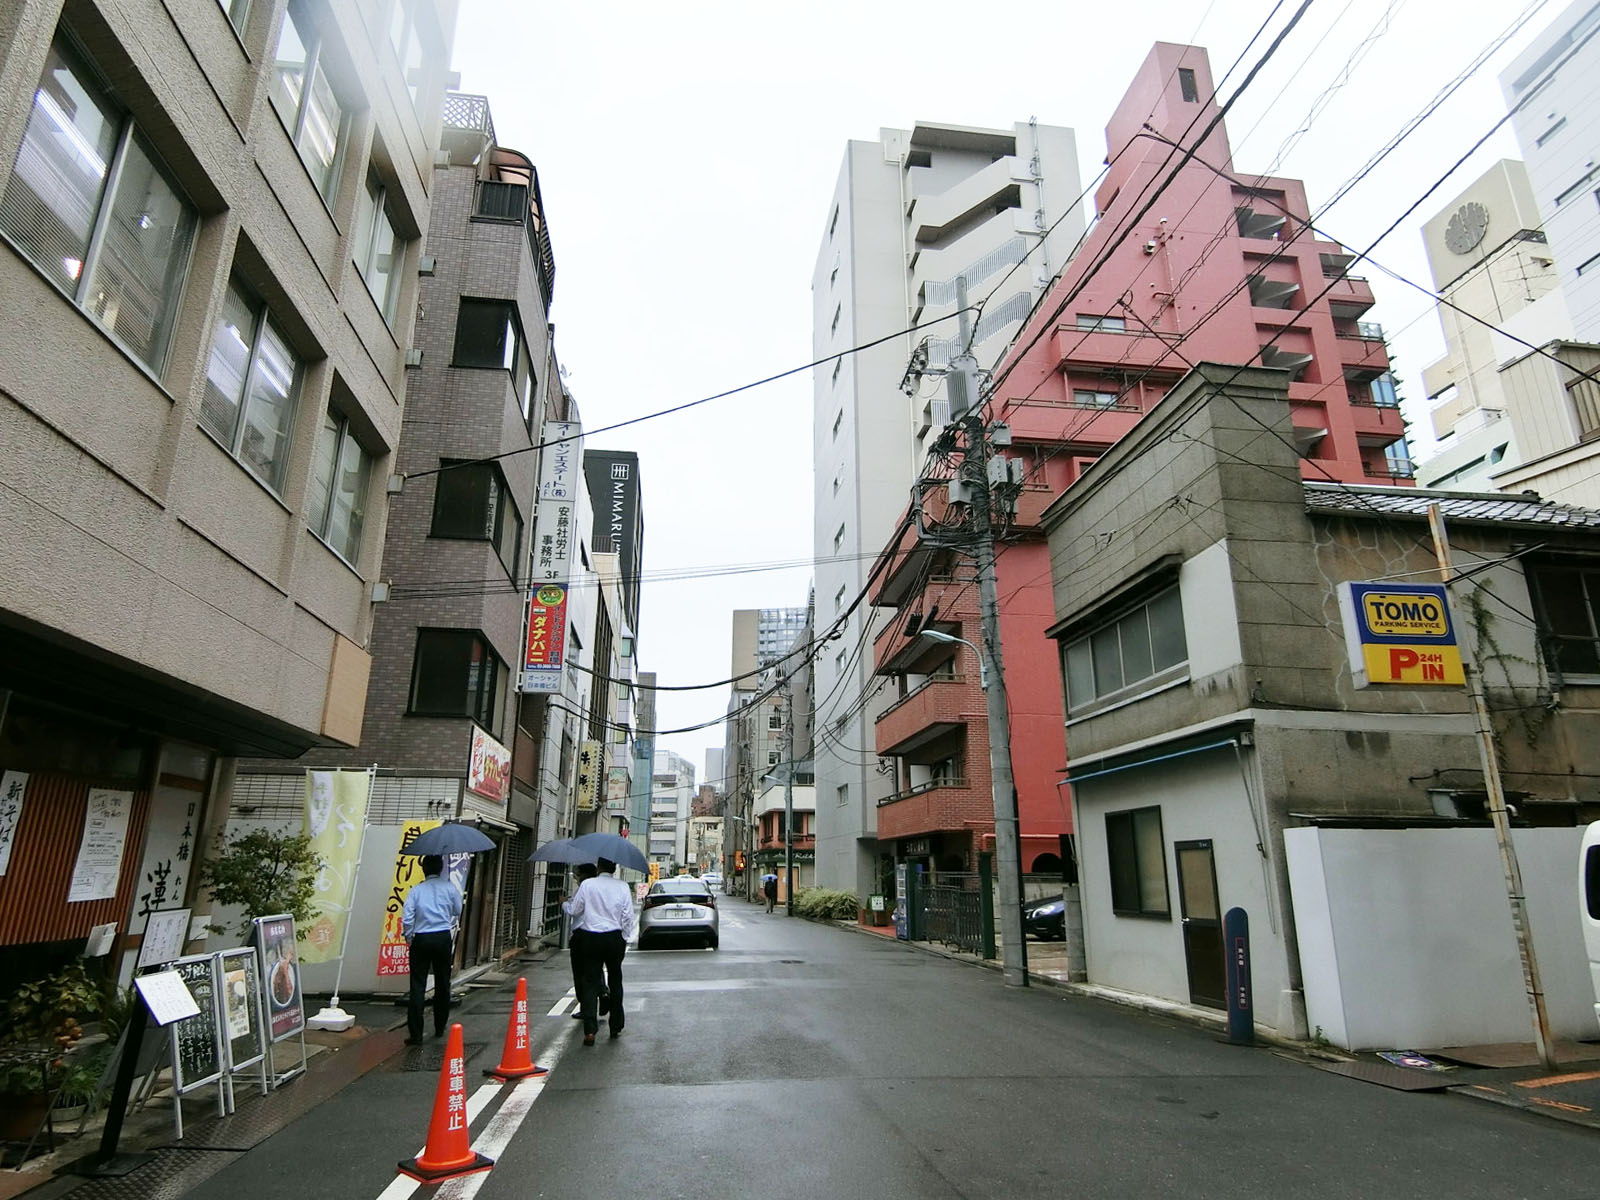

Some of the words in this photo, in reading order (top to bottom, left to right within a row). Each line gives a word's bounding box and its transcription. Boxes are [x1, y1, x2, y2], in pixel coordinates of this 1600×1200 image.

[555, 506, 570, 560] 安藤社労士
[540, 534, 554, 568] 事務所
[545, 571, 559, 580] 3F
[1370, 602, 1439, 621] TOMO
[1389, 648, 1419, 680] P
[1420, 654, 1442, 662] 24H
[1422, 664, 1444, 680] IN
[176, 802, 196, 862] 日本橋
[515, 1000, 528, 1049] 駐車禁止
[448, 1057, 464, 1131] 駐車禁止
